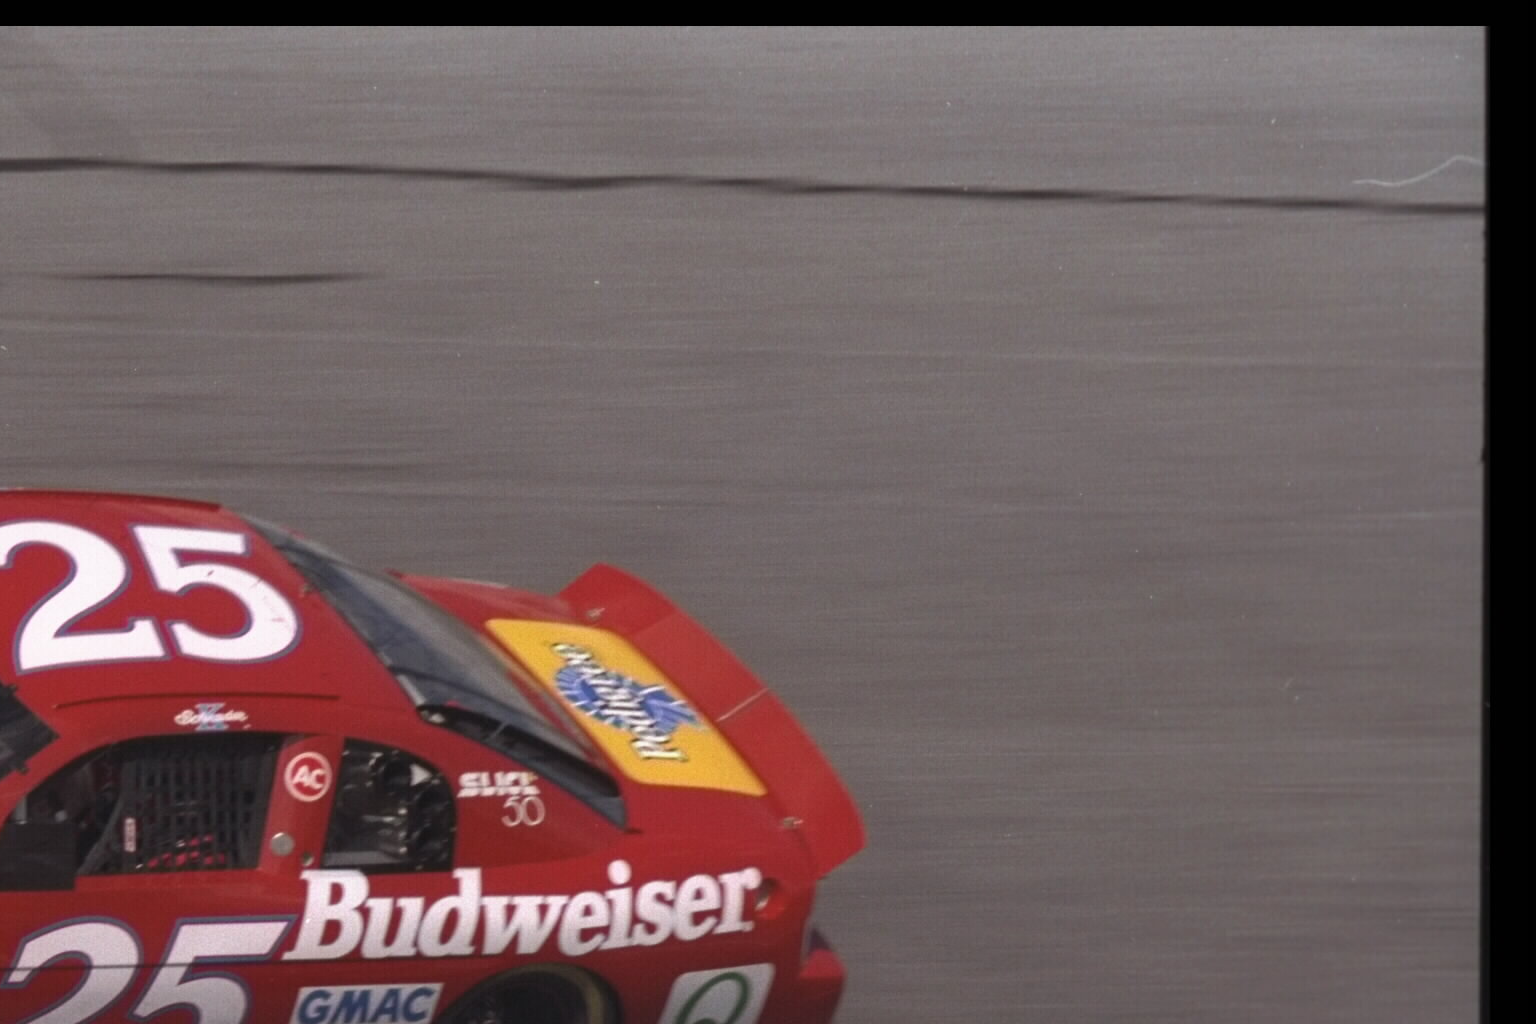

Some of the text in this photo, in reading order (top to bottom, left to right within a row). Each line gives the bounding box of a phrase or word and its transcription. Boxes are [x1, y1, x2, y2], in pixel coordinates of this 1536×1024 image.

[291, 768, 326, 789] AC
[501, 796, 546, 827] 50
[283, 859, 762, 962] Budweiser
